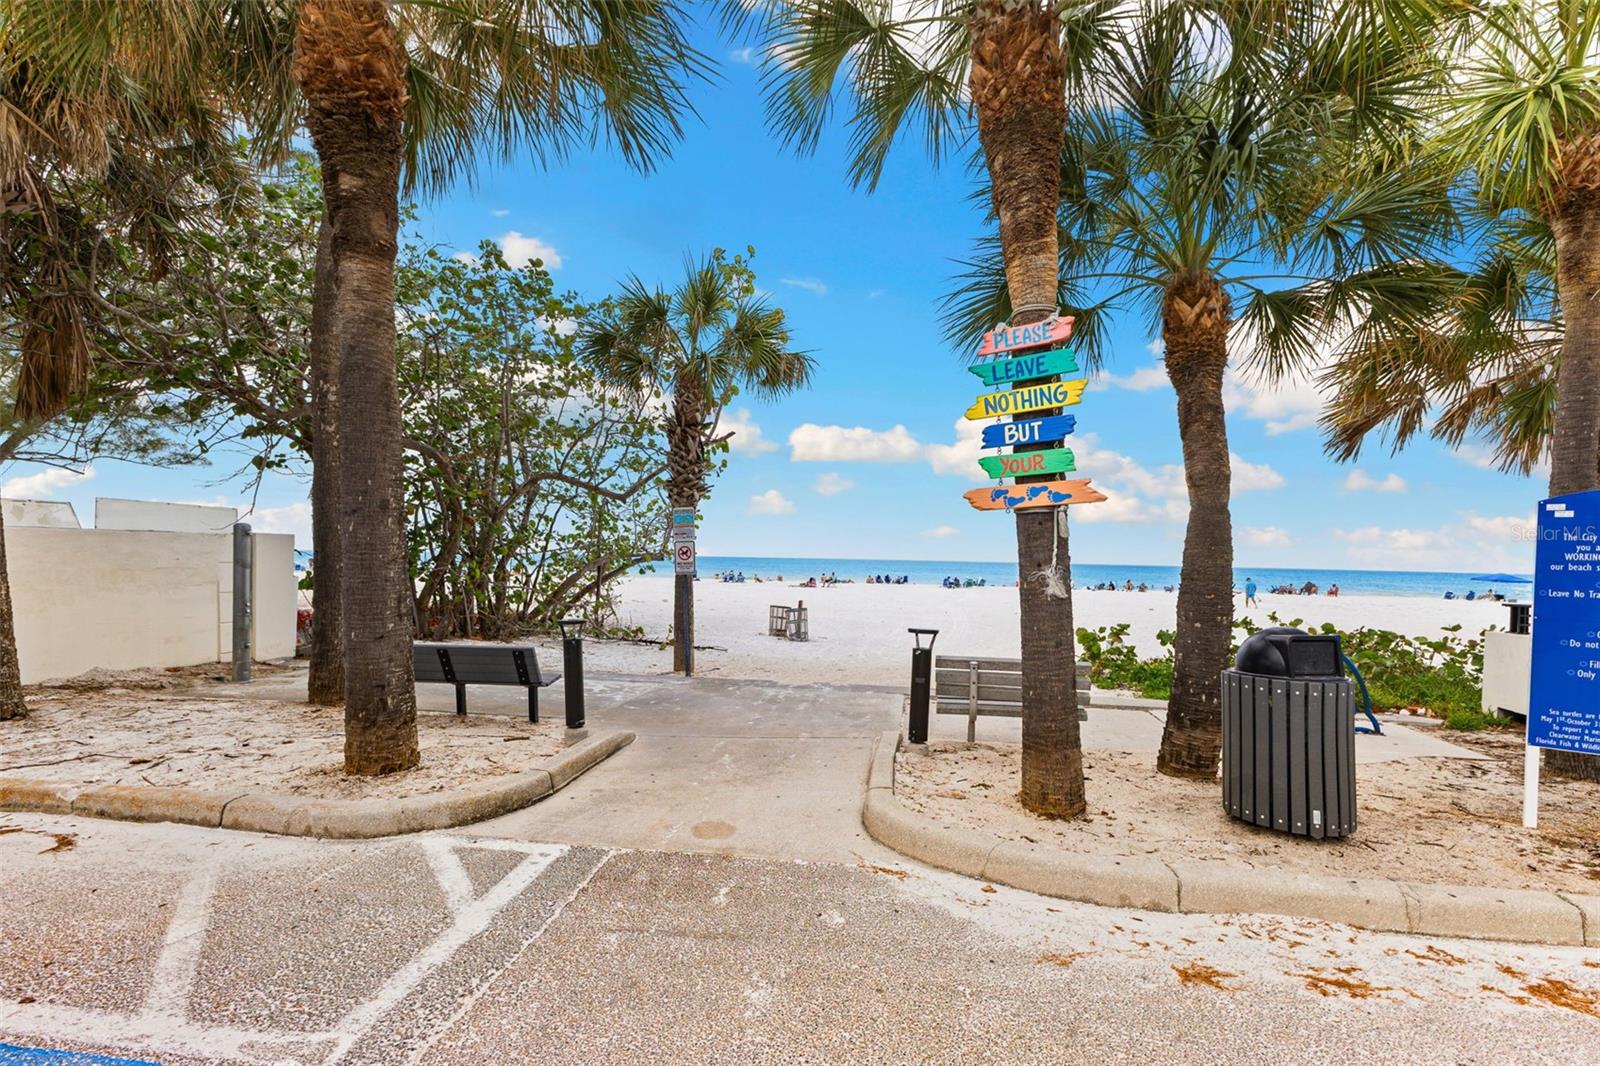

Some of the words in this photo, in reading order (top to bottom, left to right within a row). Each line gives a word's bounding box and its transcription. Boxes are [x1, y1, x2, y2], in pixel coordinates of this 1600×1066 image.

[992, 322, 1054, 349] PLEASE
[991, 355, 1049, 382] LEAVE
[983, 384, 1068, 415] NOTHING
[1004, 421, 1042, 444] BUT
[999, 454, 1047, 475] YOUR
[1563, 533, 1578, 541] The
[1582, 533, 1597, 543] City
[1576, 545, 1591, 553] you
[1568, 562, 1592, 571] beach
[1548, 589, 1570, 598] Leave
[1574, 590, 1585, 598] No
[1569, 639, 1581, 648] Do
[1585, 641, 1599, 649] not
[1577, 669, 1596, 680] Only
